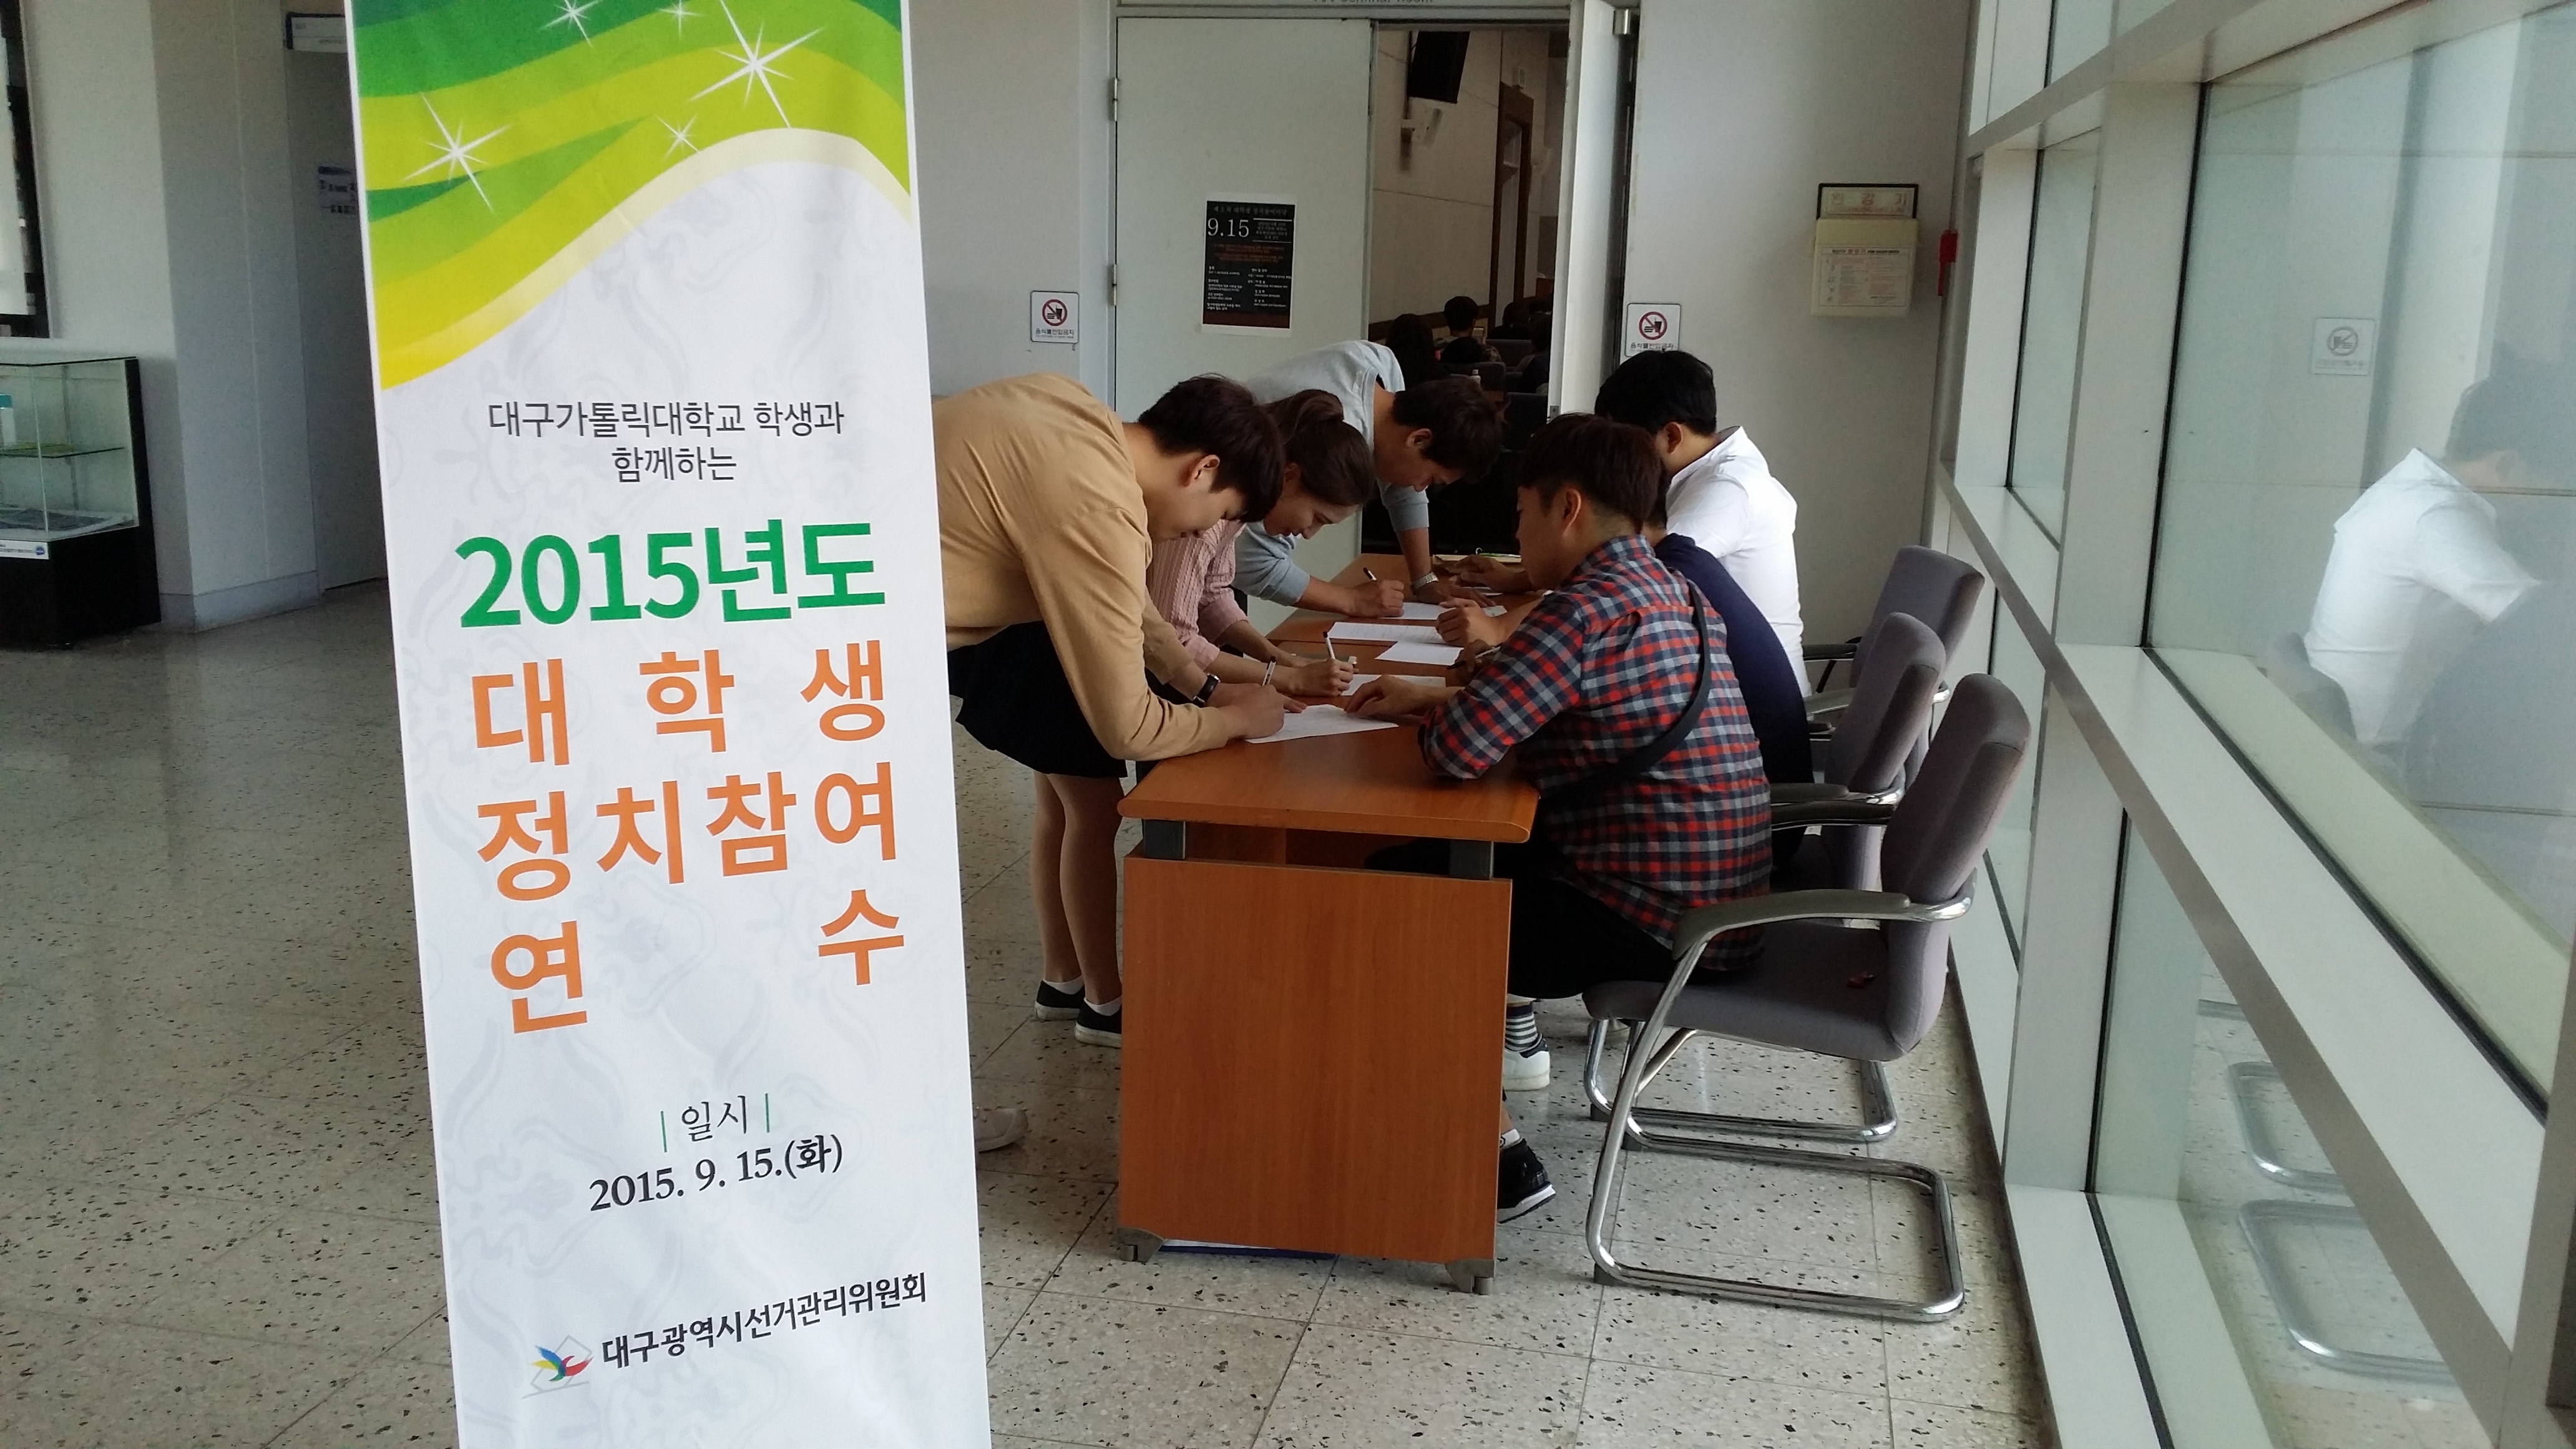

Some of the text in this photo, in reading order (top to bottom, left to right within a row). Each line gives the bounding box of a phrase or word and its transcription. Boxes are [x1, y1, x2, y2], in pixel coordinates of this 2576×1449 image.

[1208, 218, 1250, 238] 9.15
[489, 401, 844, 437] 대구가톨릭대학교 학생과
[612, 447, 736, 482] 함께하는
[455, 519, 885, 628] 2015년도
[682, 1096, 746, 1141] 일시
[590, 1168, 683, 1211] 2015.
[602, 1272, 925, 1368] 대구광역시선거관리위원회
